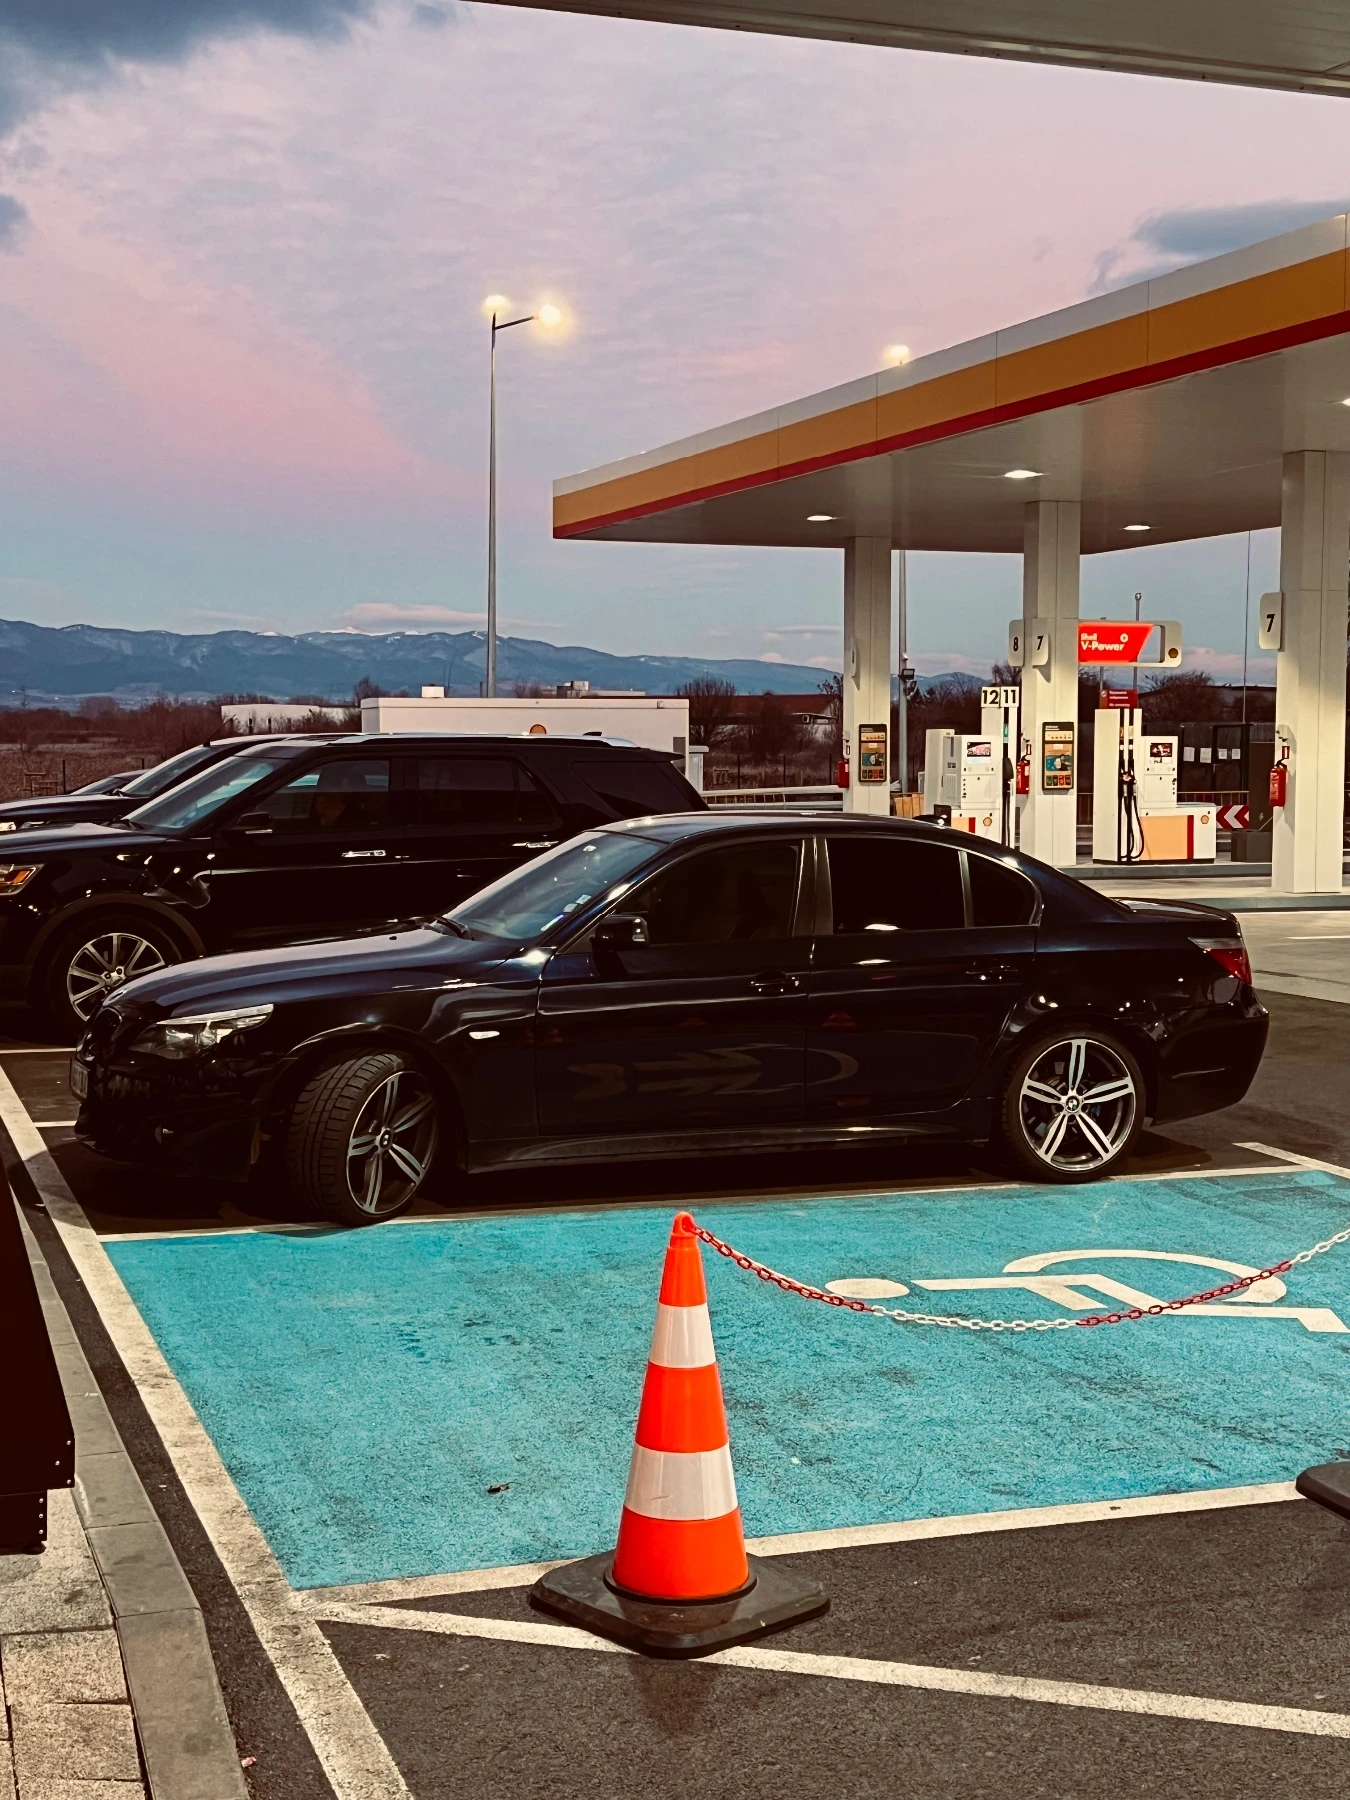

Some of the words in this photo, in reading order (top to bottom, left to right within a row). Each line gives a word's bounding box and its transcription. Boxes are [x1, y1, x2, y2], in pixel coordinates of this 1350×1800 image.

[1266, 613, 1275, 632] 7
[1013, 637, 1018, 651] 8
[1037, 635, 1044, 650] 7
[1081, 641, 1125, 651] V-Power
[982, 690, 999, 704] 12
[1003, 690, 1016, 704] 11
